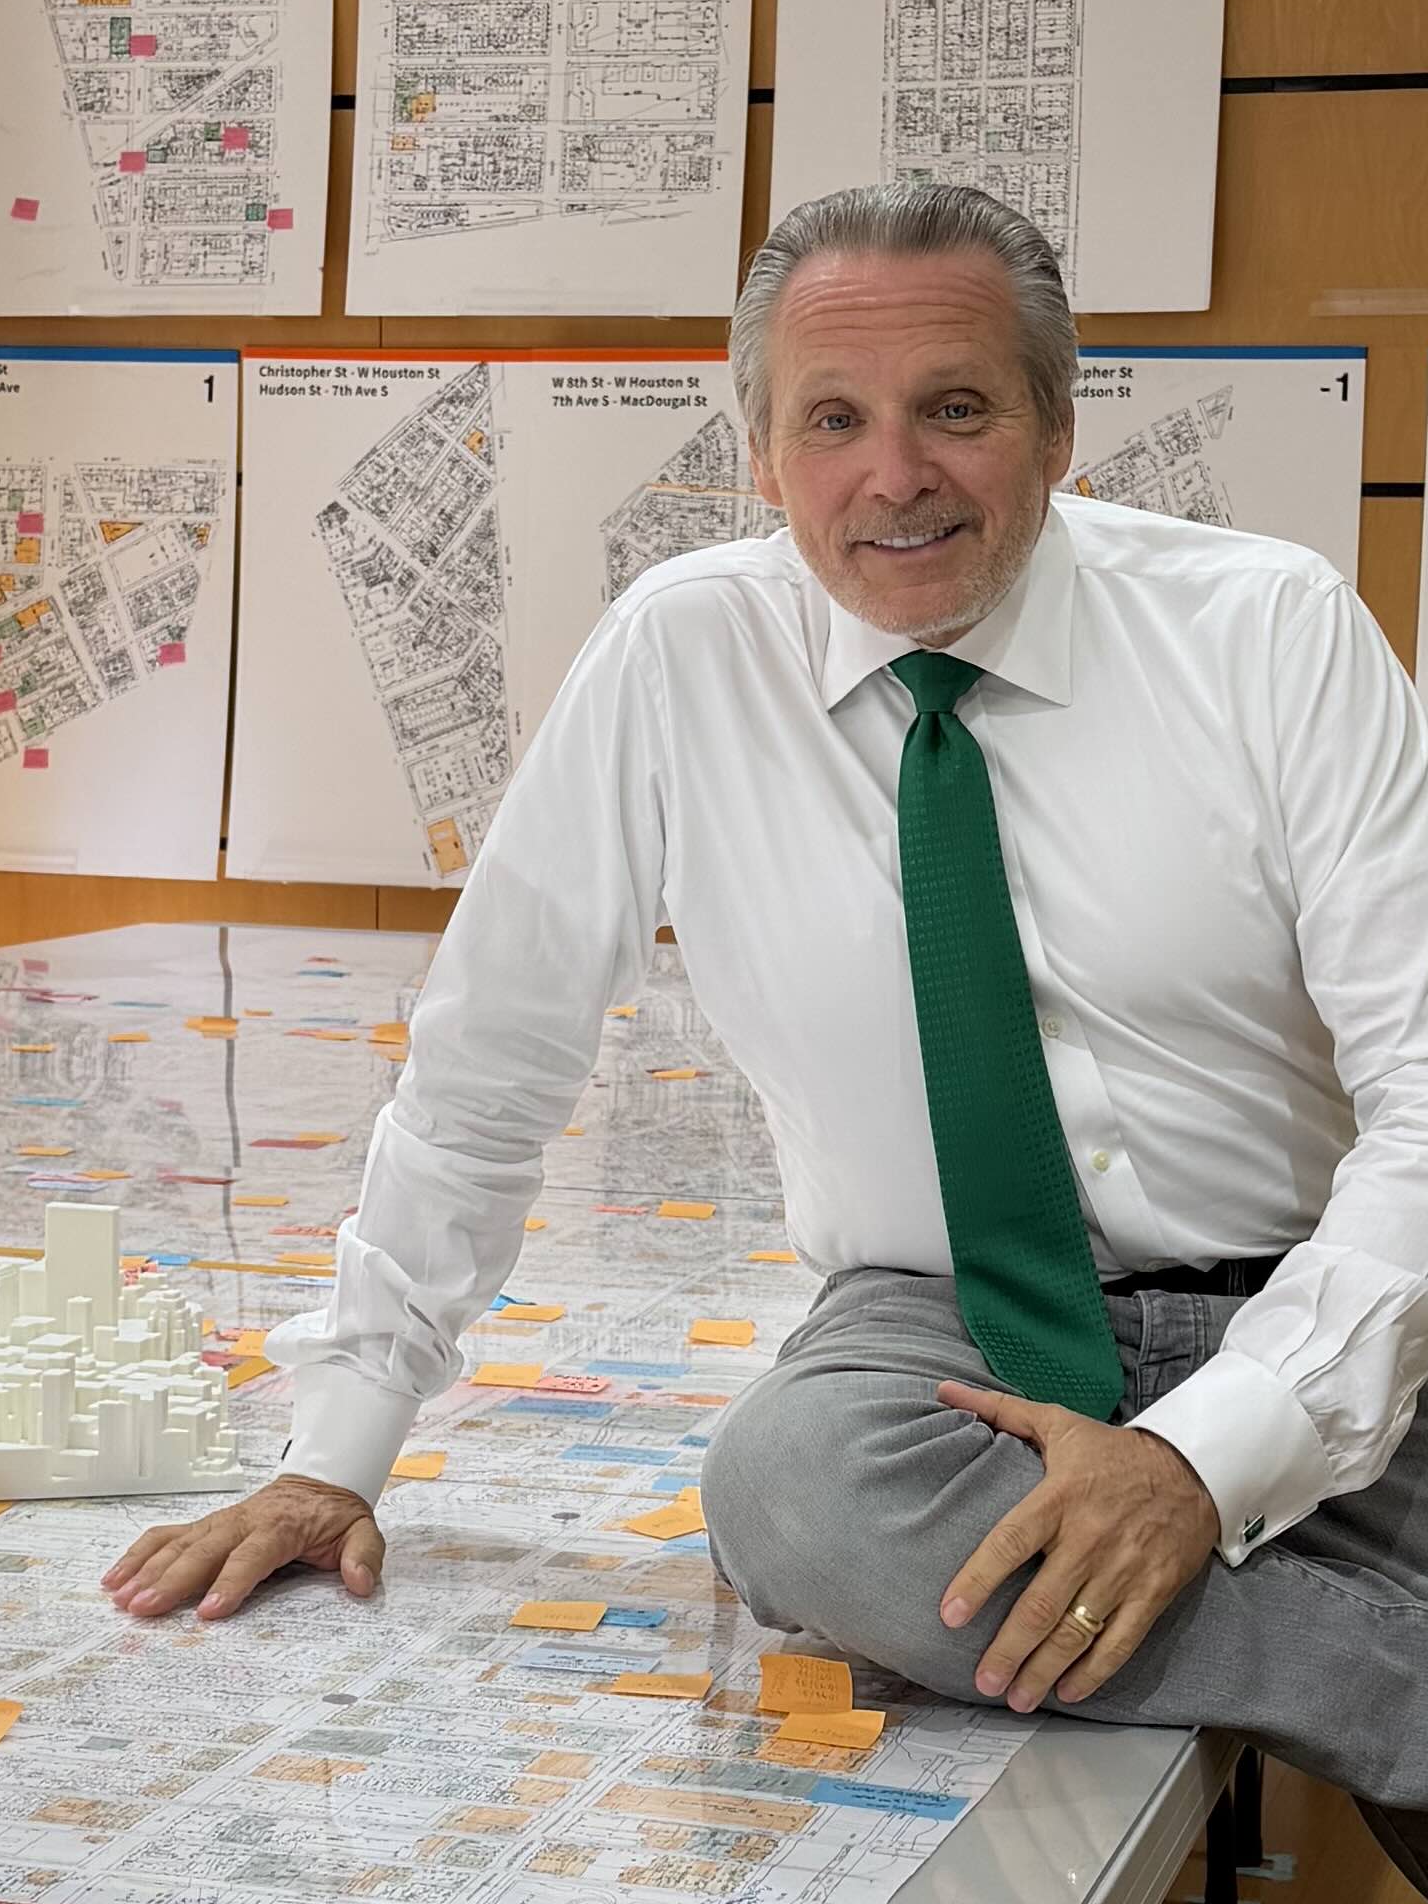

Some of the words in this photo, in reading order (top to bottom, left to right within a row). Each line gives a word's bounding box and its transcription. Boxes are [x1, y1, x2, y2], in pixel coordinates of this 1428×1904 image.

[259, 365, 333, 382] Christopher
[335, 366, 348, 379] St
[357, 367, 369, 379] W
[372, 366, 424, 380] Houston
[427, 367, 440, 380] St
[1119, 367, 1133, 380] St
[203, 375, 215, 403] 1
[552, 376, 563, 388] W
[566, 376, 585, 388] 8th
[589, 376, 604, 389] St
[613, 376, 626, 389] W
[629, 376, 684, 389] Houston
[687, 376, 700, 389] St
[259, 383, 306, 396] Hudson
[308, 384, 322, 396] St
[332, 383, 351, 397] 7th
[353, 384, 377, 397] Ave
[380, 384, 389, 397] S
[1072, 385, 1112, 398] udson
[1117, 385, 1132, 398] St
[552, 395, 572, 407] 7th
[575, 395, 599, 407] Ave
[602, 395, 610, 407] S
[621, 395, 692, 410] MacDougal
[694, 394, 708, 407] St
